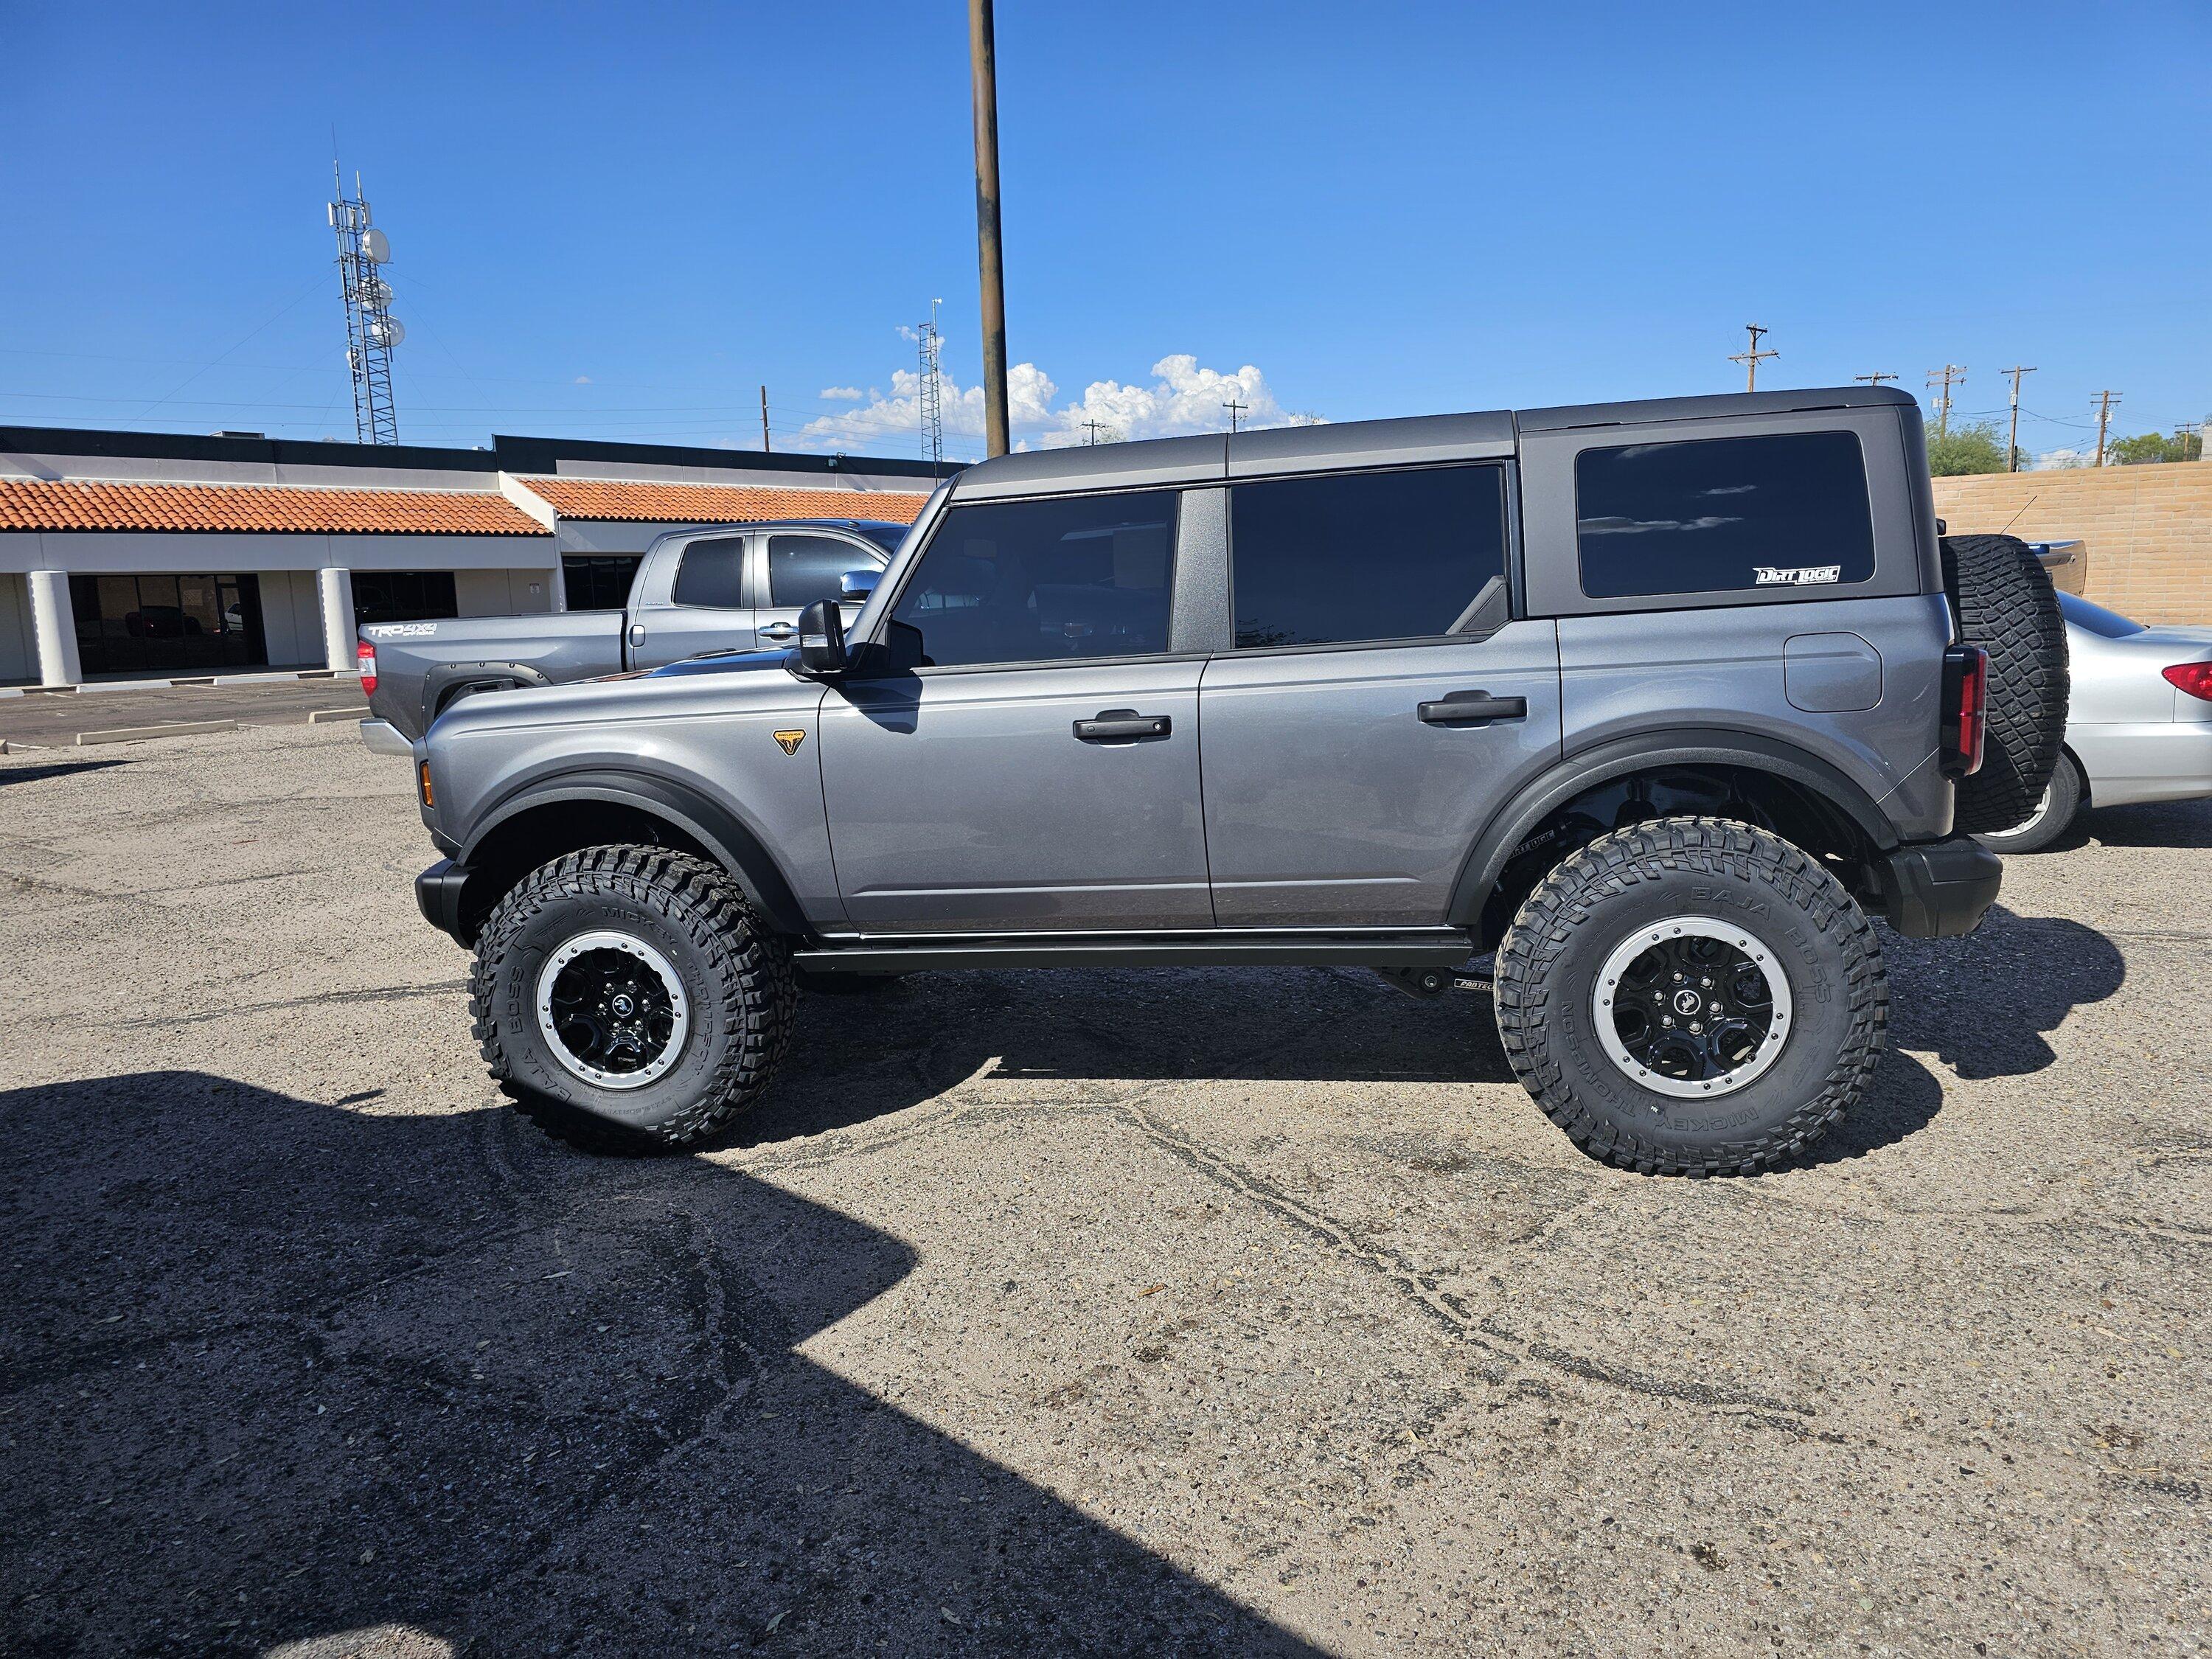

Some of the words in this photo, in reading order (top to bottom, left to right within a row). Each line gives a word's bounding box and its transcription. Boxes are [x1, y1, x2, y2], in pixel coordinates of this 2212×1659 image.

[1759, 569, 1797, 582] DIRT
[1798, 567, 1838, 582] LOGIC
[369, 625, 404, 638] TRD
[602, 906, 678, 945] MICKEY
[1691, 887, 1770, 921] BAJA
[1784, 927, 1832, 1004] BOSS
[507, 965, 525, 1034] BOSS
[1460, 981, 1494, 990] FABTEC
[522, 1047, 572, 1103] BAJA
[1561, 1001, 1635, 1117] THOMPSON
[1654, 1107, 1759, 1131] MICKEY
